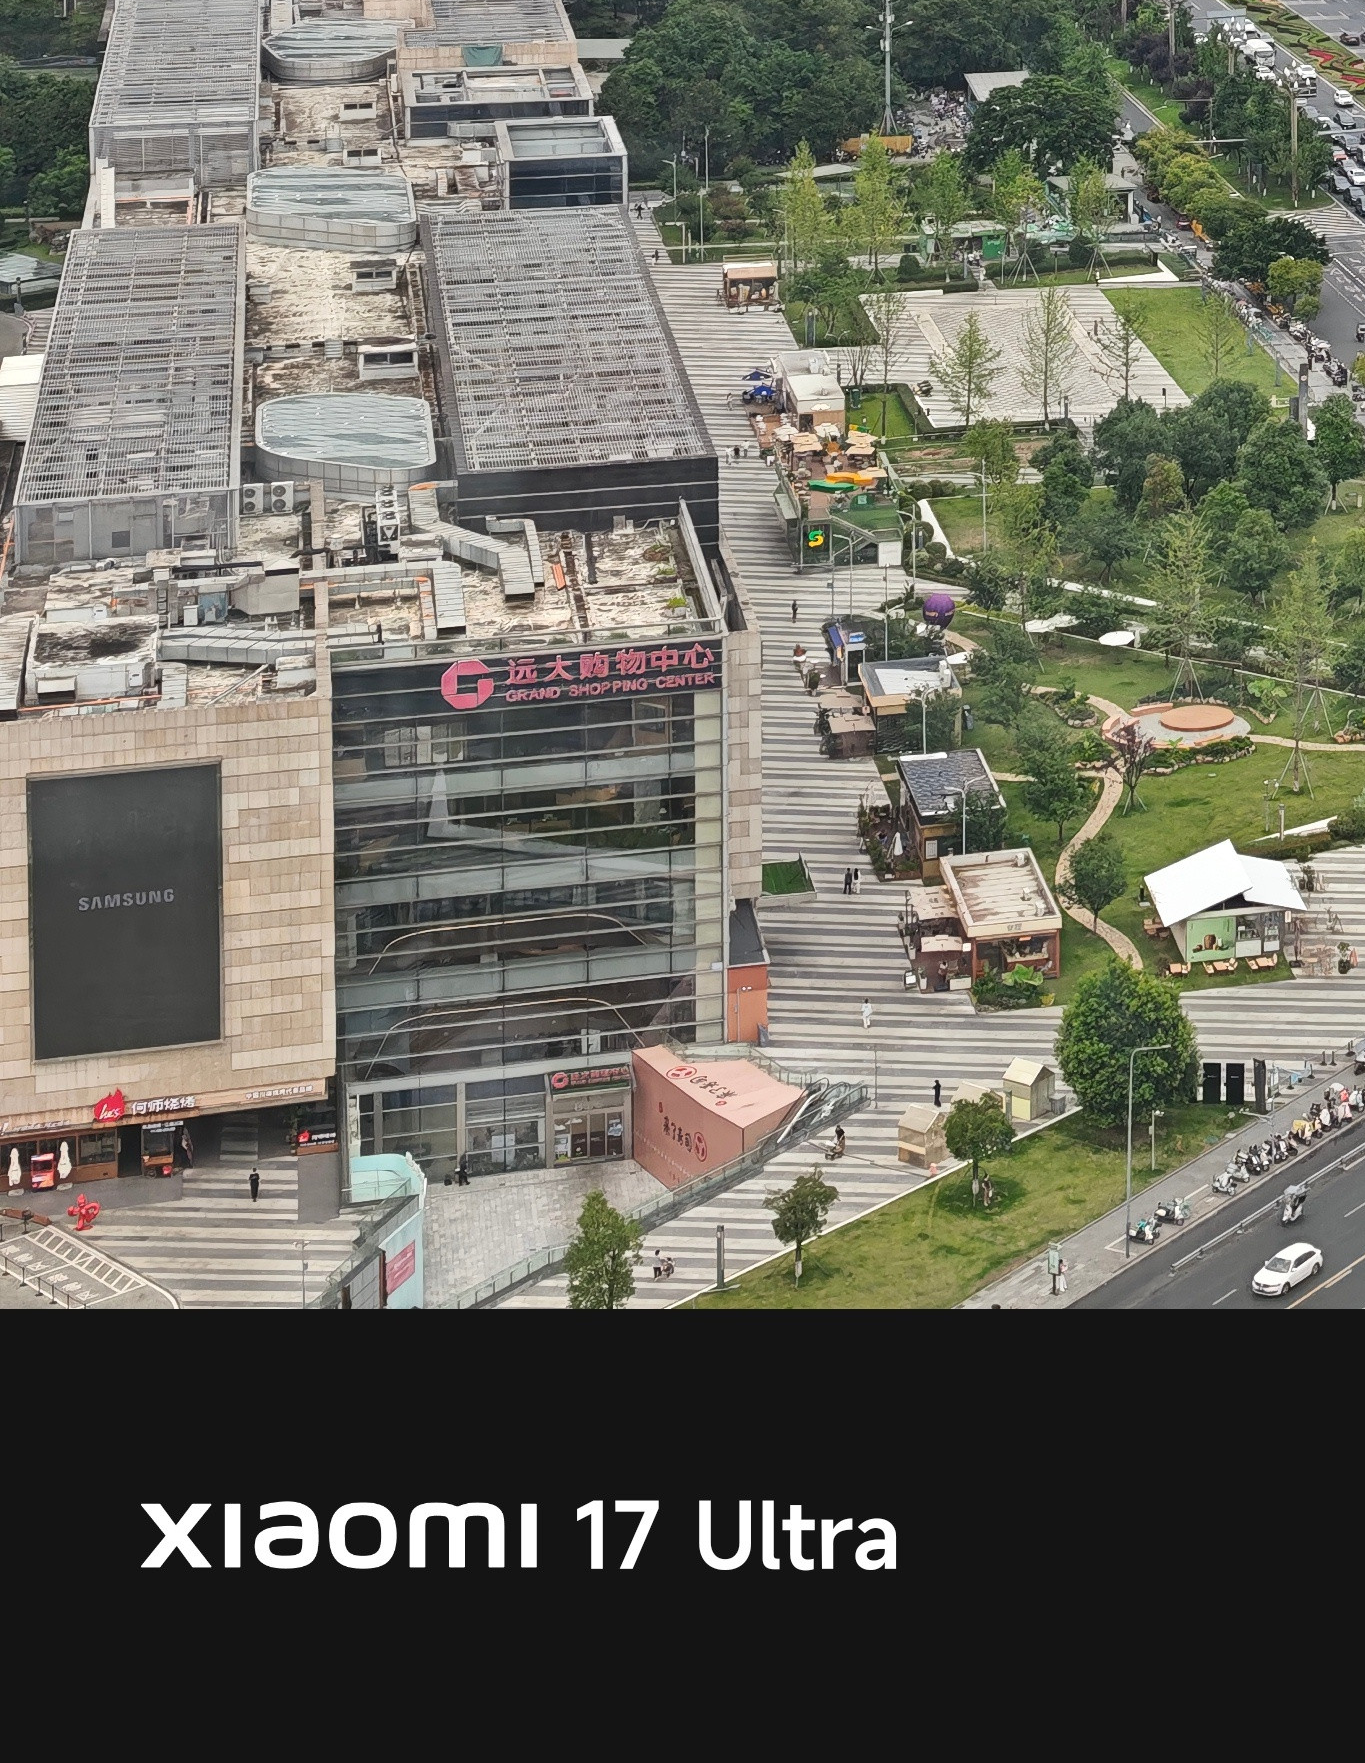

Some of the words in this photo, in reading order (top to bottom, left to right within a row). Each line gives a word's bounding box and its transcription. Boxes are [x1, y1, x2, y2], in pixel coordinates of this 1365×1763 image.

[507, 642, 715, 685] 远大购物中心
[505, 687, 562, 703] GRAND
[568, 678, 649, 697] SHOPPING
[655, 671, 716, 689] CENTER
[78, 887, 175, 912] SAMSUNG
[131, 1095, 196, 1115] 何师烧烤
